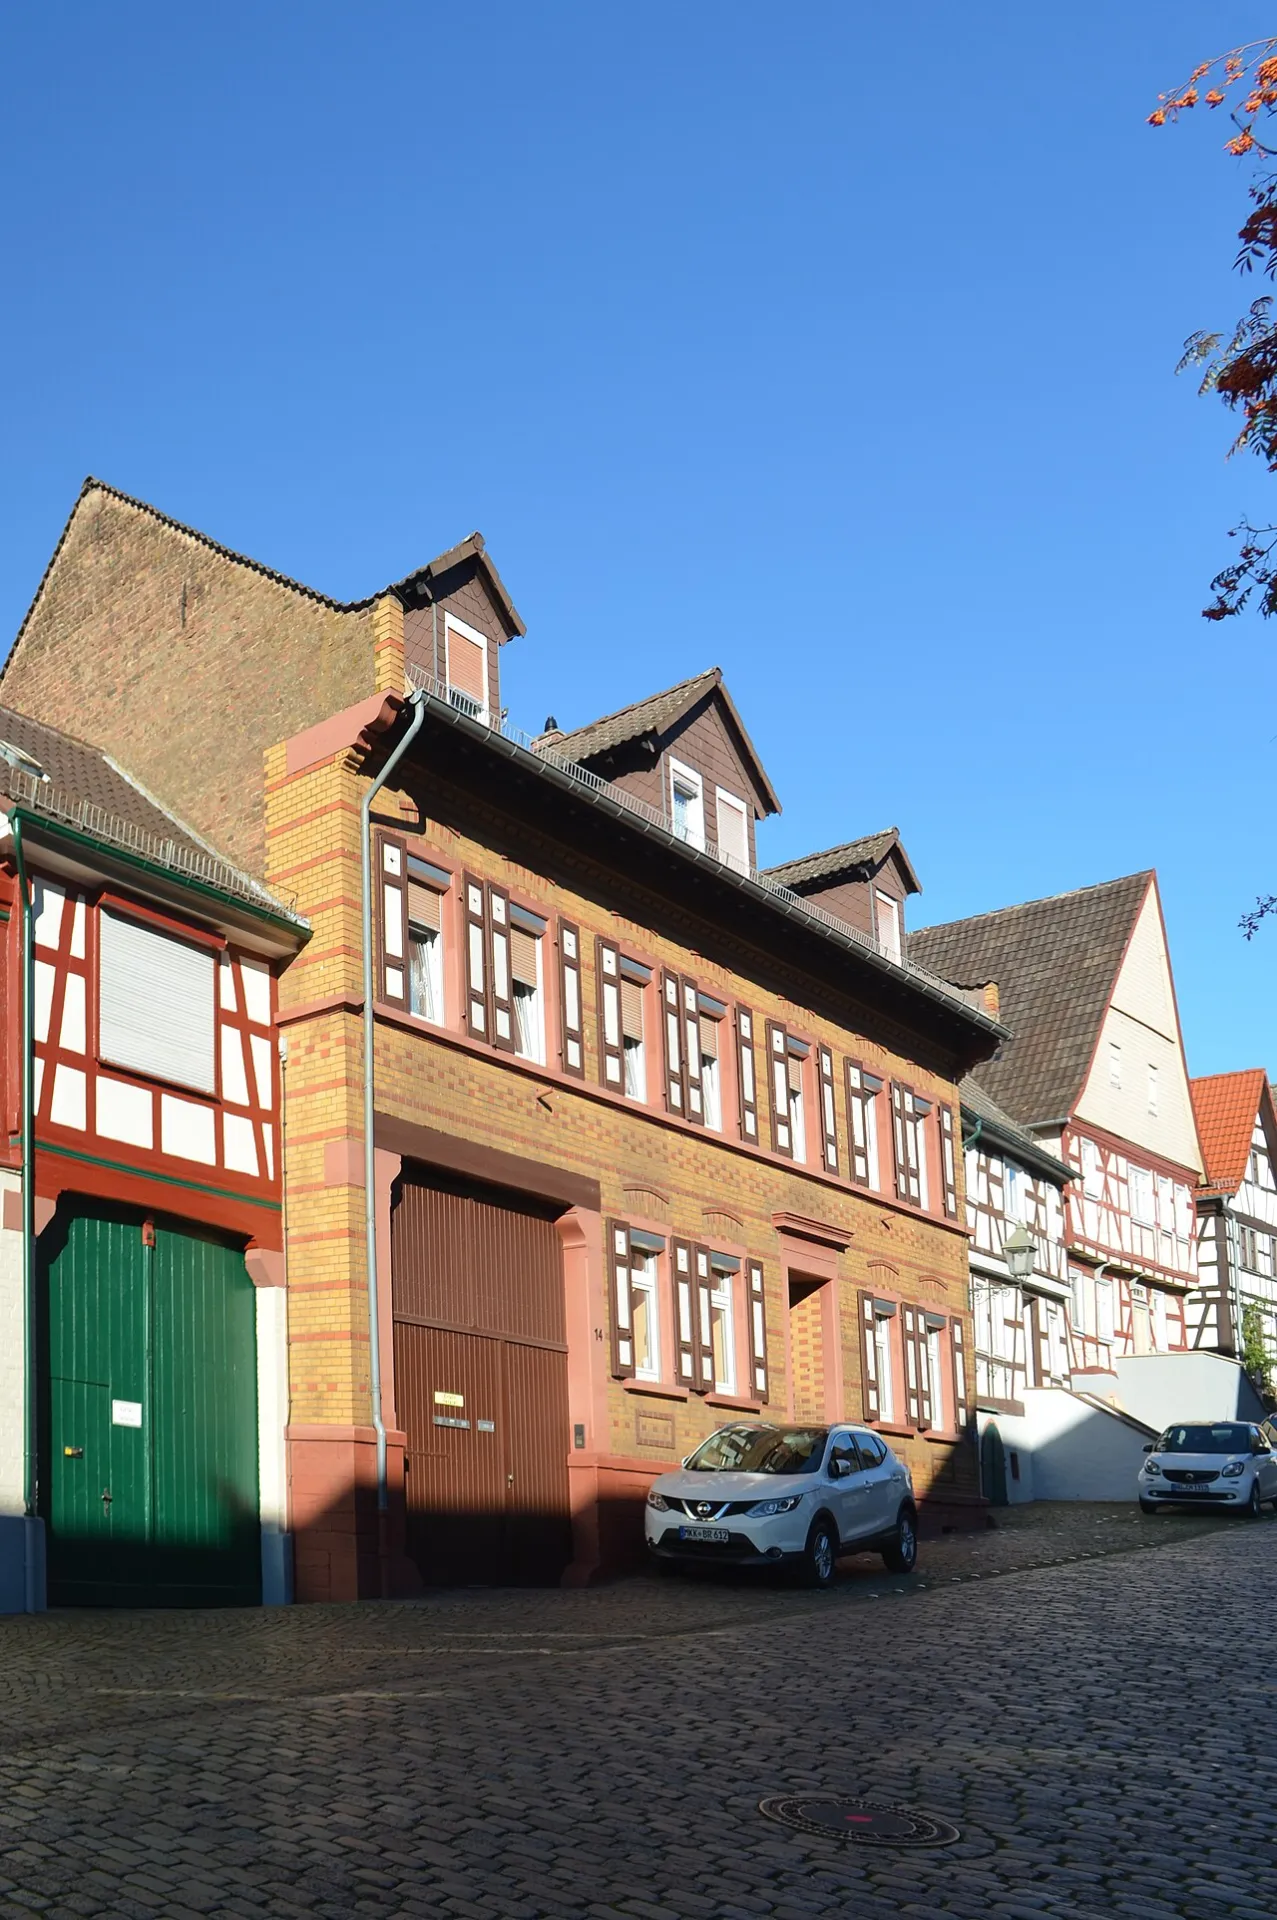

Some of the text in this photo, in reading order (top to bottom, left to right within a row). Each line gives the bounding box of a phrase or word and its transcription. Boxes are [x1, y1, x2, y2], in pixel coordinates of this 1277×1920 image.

[594, 1328, 603, 1341] 14
[685, 1528, 728, 1540] MKK BR 612
